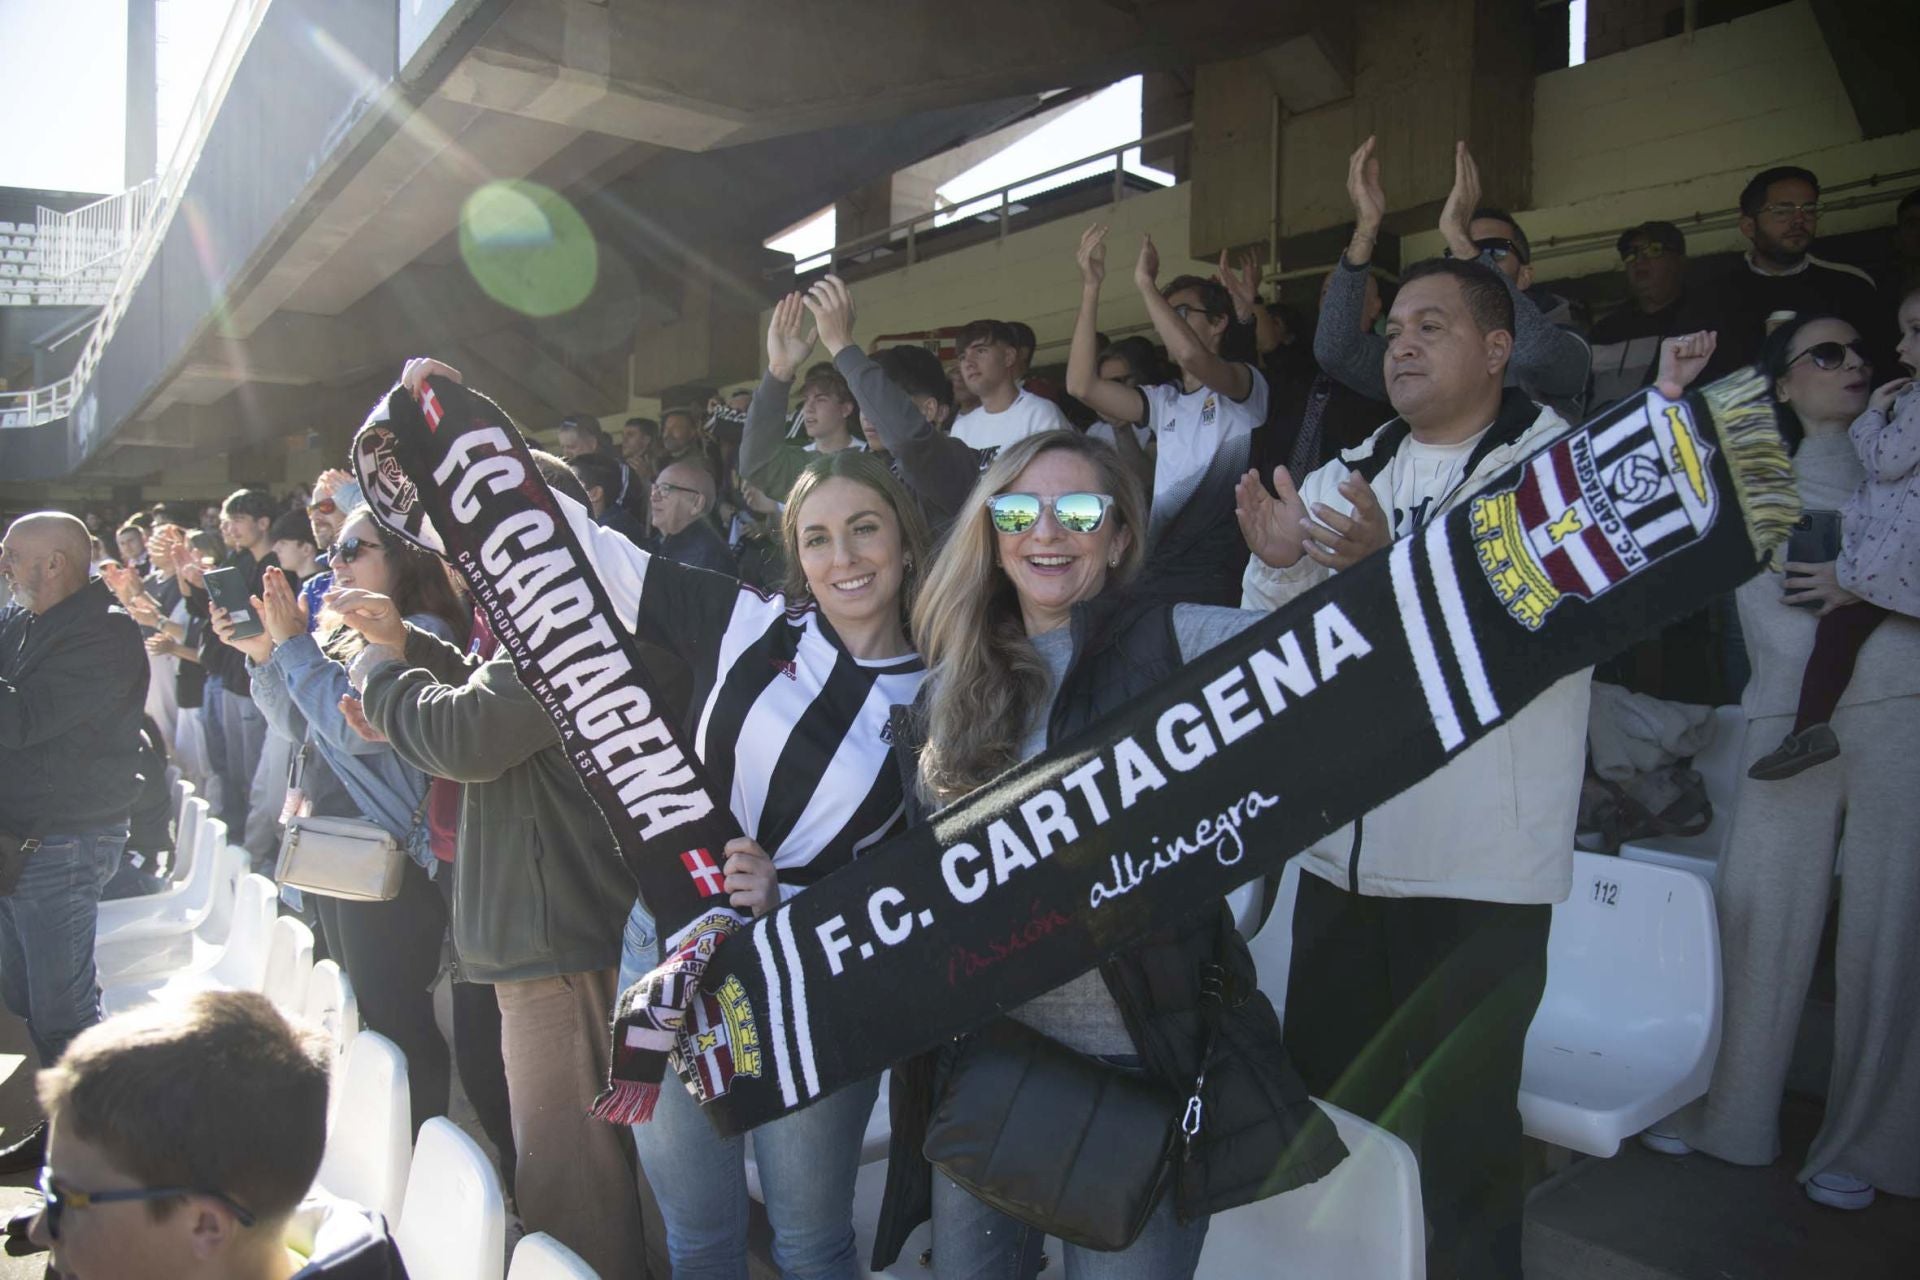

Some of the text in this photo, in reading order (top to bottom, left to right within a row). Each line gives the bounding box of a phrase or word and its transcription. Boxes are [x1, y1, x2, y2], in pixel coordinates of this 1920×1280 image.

[1572, 435, 1642, 567] F.C. CARTAGENA
[432, 426, 715, 842] FC CARTAGENA
[458, 551, 598, 778] CARTHAGONOVA INVICTA EST
[815, 601, 1374, 976] F.C. CARTAGENA
[1090, 790, 1279, 909] albinegra
[1593, 879, 1618, 905] 112
